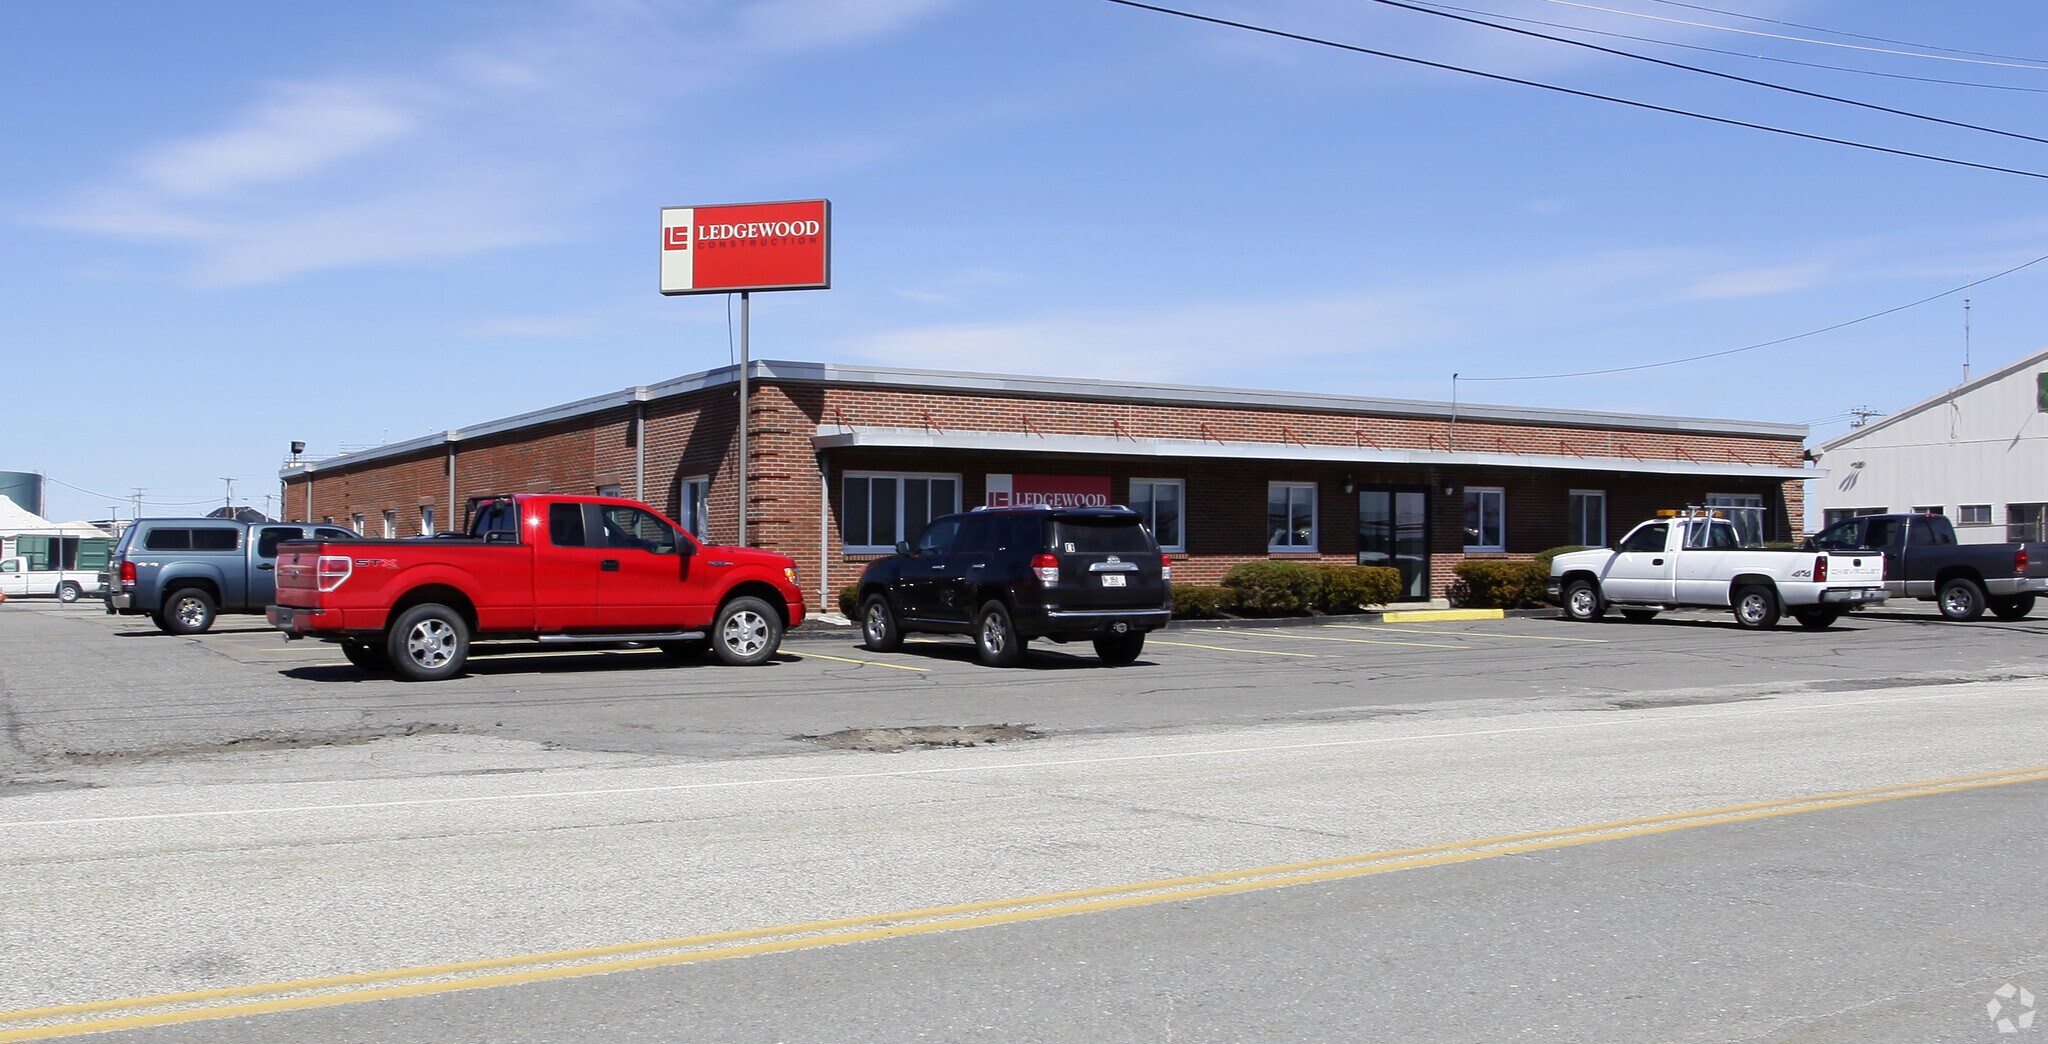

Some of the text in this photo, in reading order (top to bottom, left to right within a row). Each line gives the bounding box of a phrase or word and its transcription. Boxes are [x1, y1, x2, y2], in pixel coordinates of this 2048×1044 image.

[698, 220, 820, 241] LEDGEWOOD
[697, 236, 817, 250] CONSTRUCTION
[1015, 492, 1107, 508] LEDGEWOOD
[355, 559, 399, 569] STX
